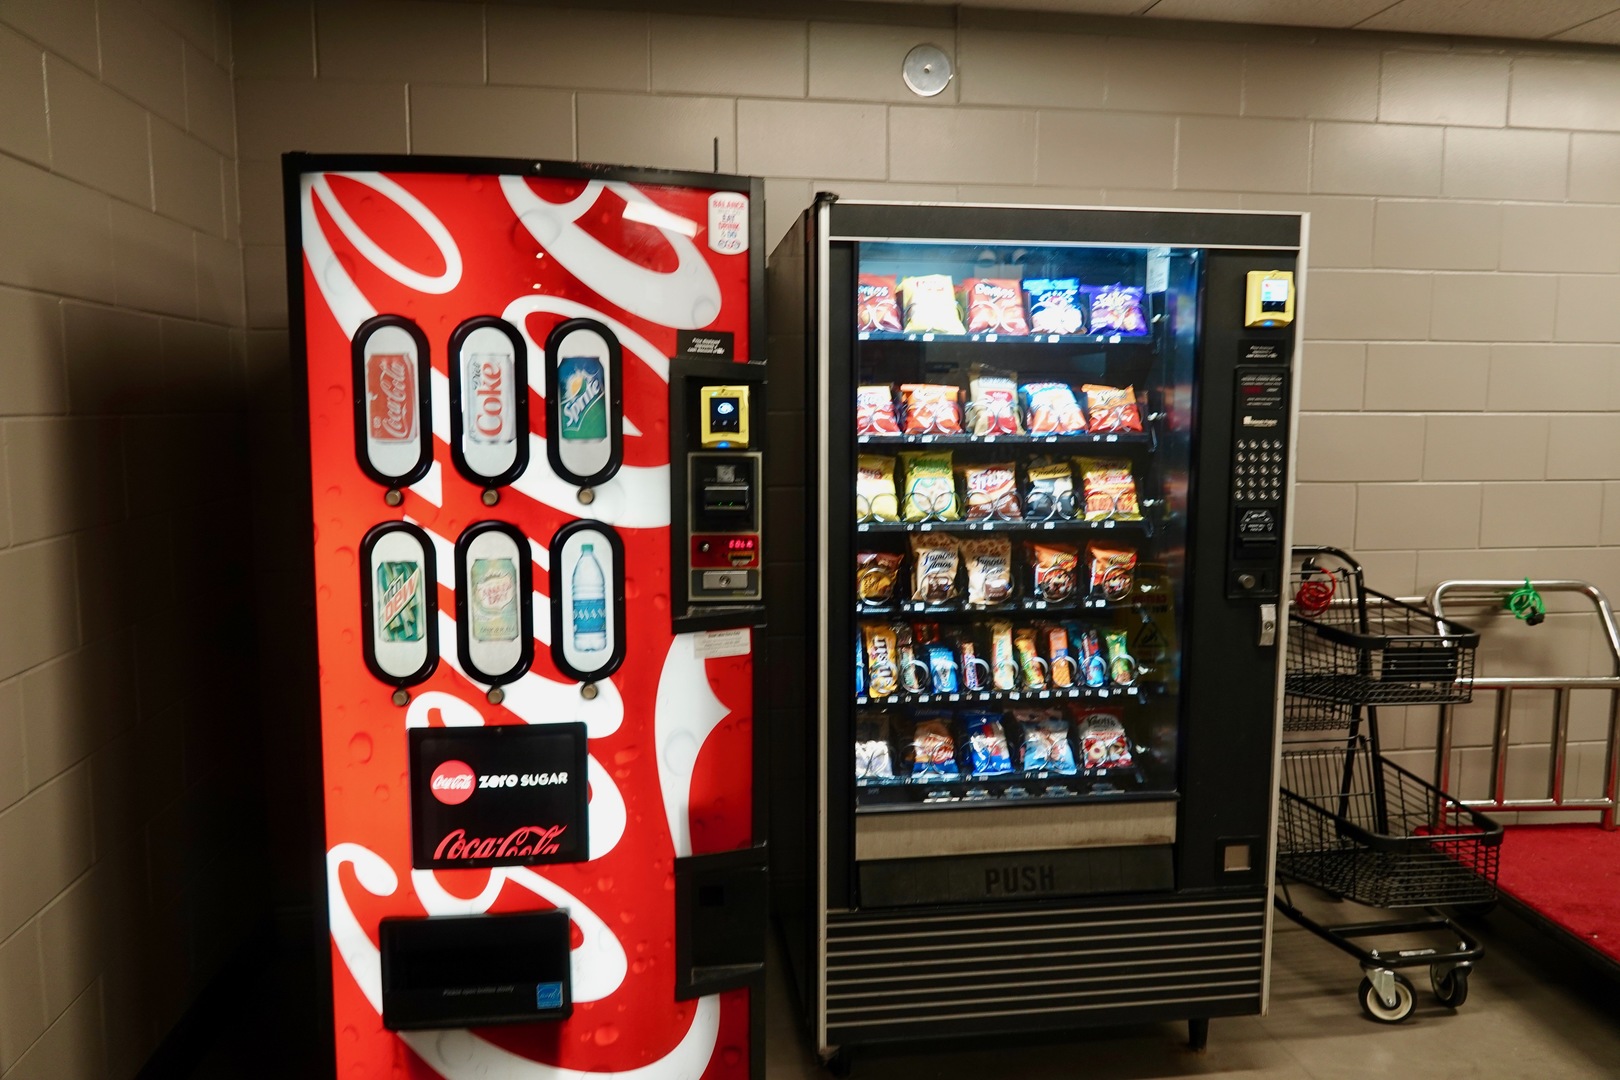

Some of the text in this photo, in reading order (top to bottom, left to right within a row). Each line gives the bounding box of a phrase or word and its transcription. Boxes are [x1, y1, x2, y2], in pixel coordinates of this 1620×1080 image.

[974, 282, 1016, 299] Doritos
[475, 361, 503, 437] Coke
[562, 378, 602, 428] Sprite
[432, 772, 568, 790] Coca-Cola zero SUGAR
[985, 865, 1054, 895] PUSH
